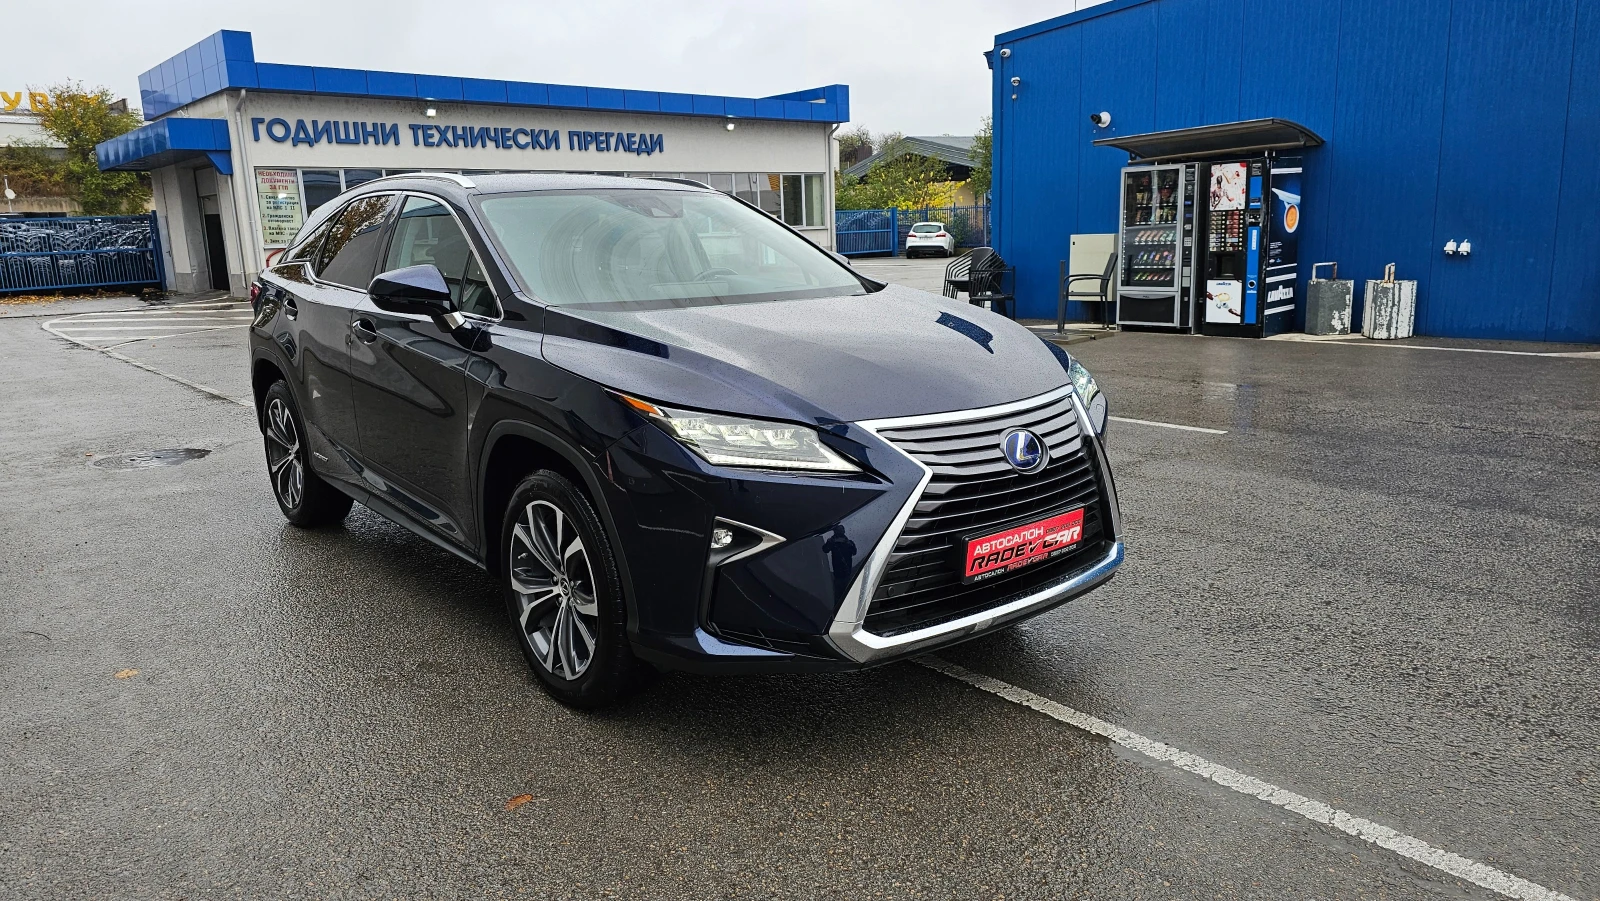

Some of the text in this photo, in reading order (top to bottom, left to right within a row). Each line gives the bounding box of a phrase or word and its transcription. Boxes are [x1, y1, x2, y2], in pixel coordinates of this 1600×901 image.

[251, 117, 665, 156] ГОДИШНИ ТЕХНИЧЕСКИ ПРЕГЛЕДИ
[973, 527, 1044, 556] АВТОСАЛОН
